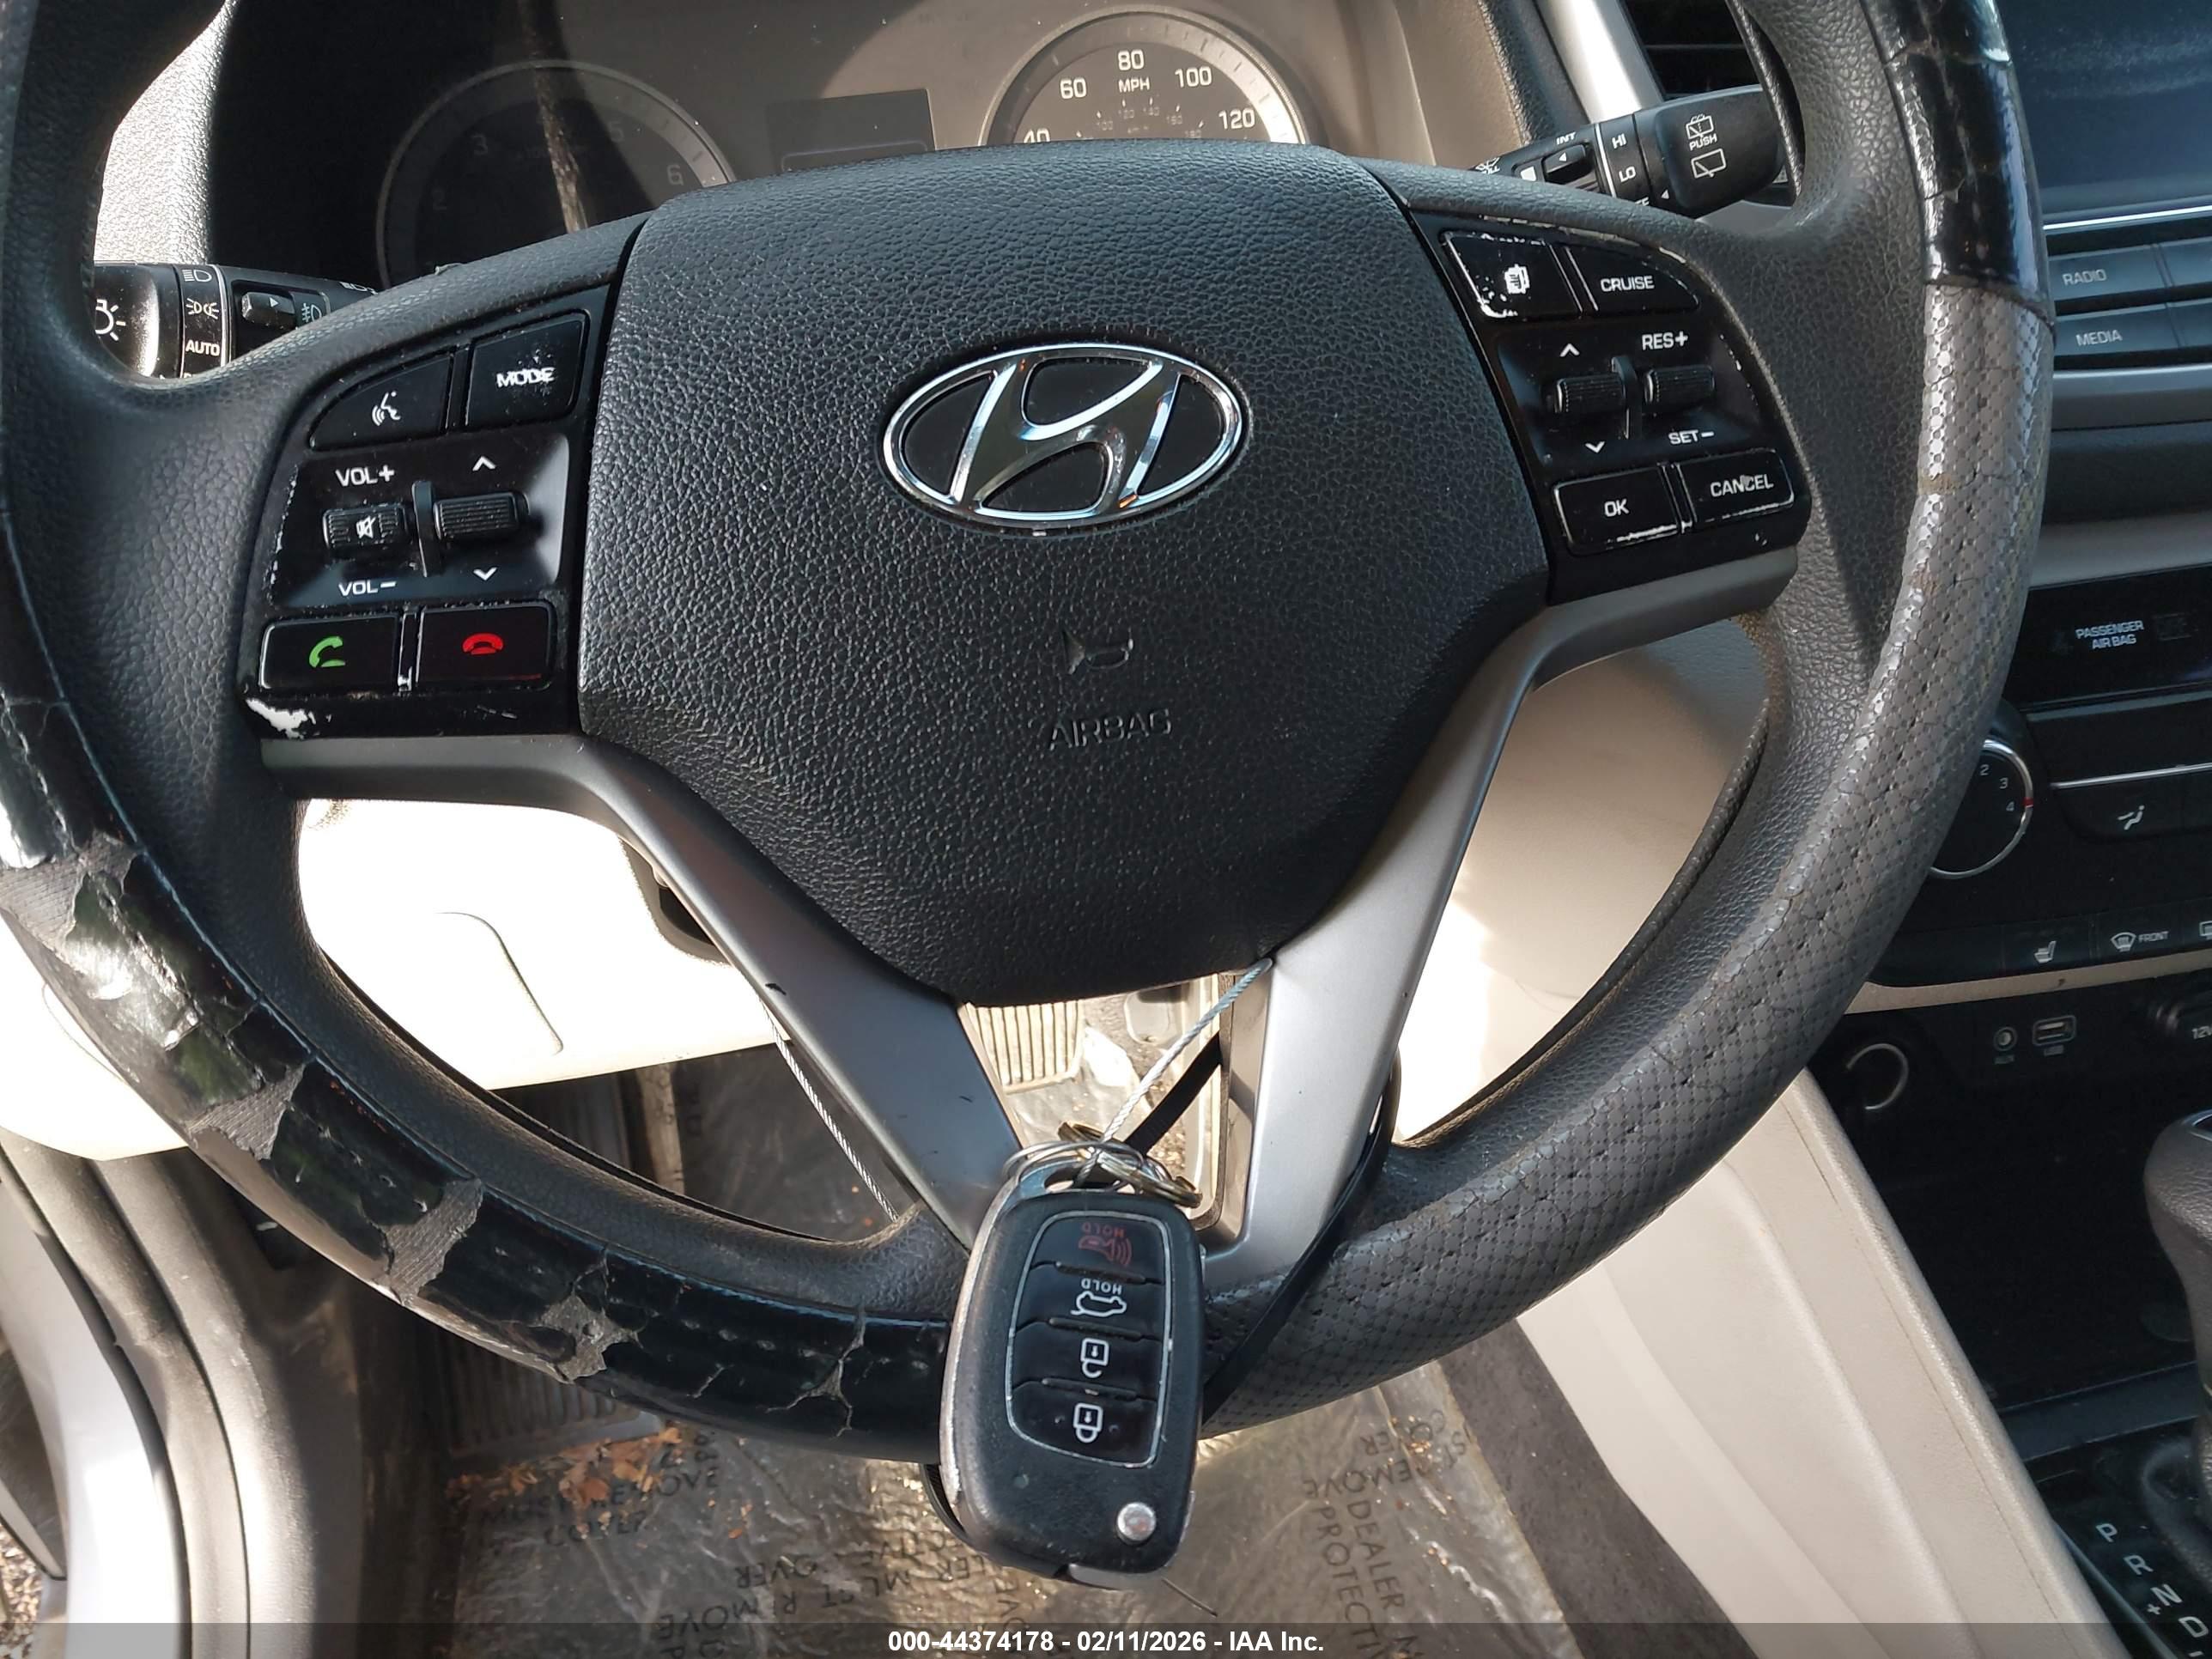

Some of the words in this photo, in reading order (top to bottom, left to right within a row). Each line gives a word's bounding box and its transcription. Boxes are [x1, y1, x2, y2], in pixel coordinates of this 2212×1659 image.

[1118, 50, 1144, 70] 80
[1118, 77, 1151, 94] MPH
[1176, 66, 1212, 88] 100
[1060, 78, 1087, 99] 60
[1218, 108, 1255, 130] 120
[471, 134, 489, 155] 3
[1556, 131, 1577, 145] INT
[1612, 133, 1628, 149] HI
[1689, 134, 1718, 151] PUSH
[667, 164, 684, 185] 6
[1620, 167, 1637, 183] LO
[1600, 274, 1655, 293] CRUISE
[2062, 269, 2107, 286] RADIO
[185, 338, 221, 357] AUTO
[1641, 330, 1689, 351] RES+
[2075, 329, 2123, 347] MEDIA
[495, 365, 556, 388] MODE
[335, 464, 395, 487] VOL+
[1710, 473, 1774, 498] CANCEL
[1603, 498, 1629, 517] OK
[2075, 619, 2145, 640] PASSENGER
[2091, 637, 2112, 650] AIR
[2112, 633, 2138, 647] BAG
[1048, 708, 1173, 751] AIRBAG
[1980, 763, 1990, 776] 2
[1999, 777, 2008, 789] 3
[2006, 801, 2014, 813] 4
[2138, 931, 2169, 944] FRONT
[1081, 1222, 1125, 1237] HOLD
[1080, 1277, 1123, 1295] HOLD
[2095, 1522, 2118, 1543] P
[1346, 1498, 1406, 1610] DEALER
[2123, 1554, 2154, 1576] R
[2150, 1583, 2183, 1607] N
[2178, 1615, 2209, 1638] D
